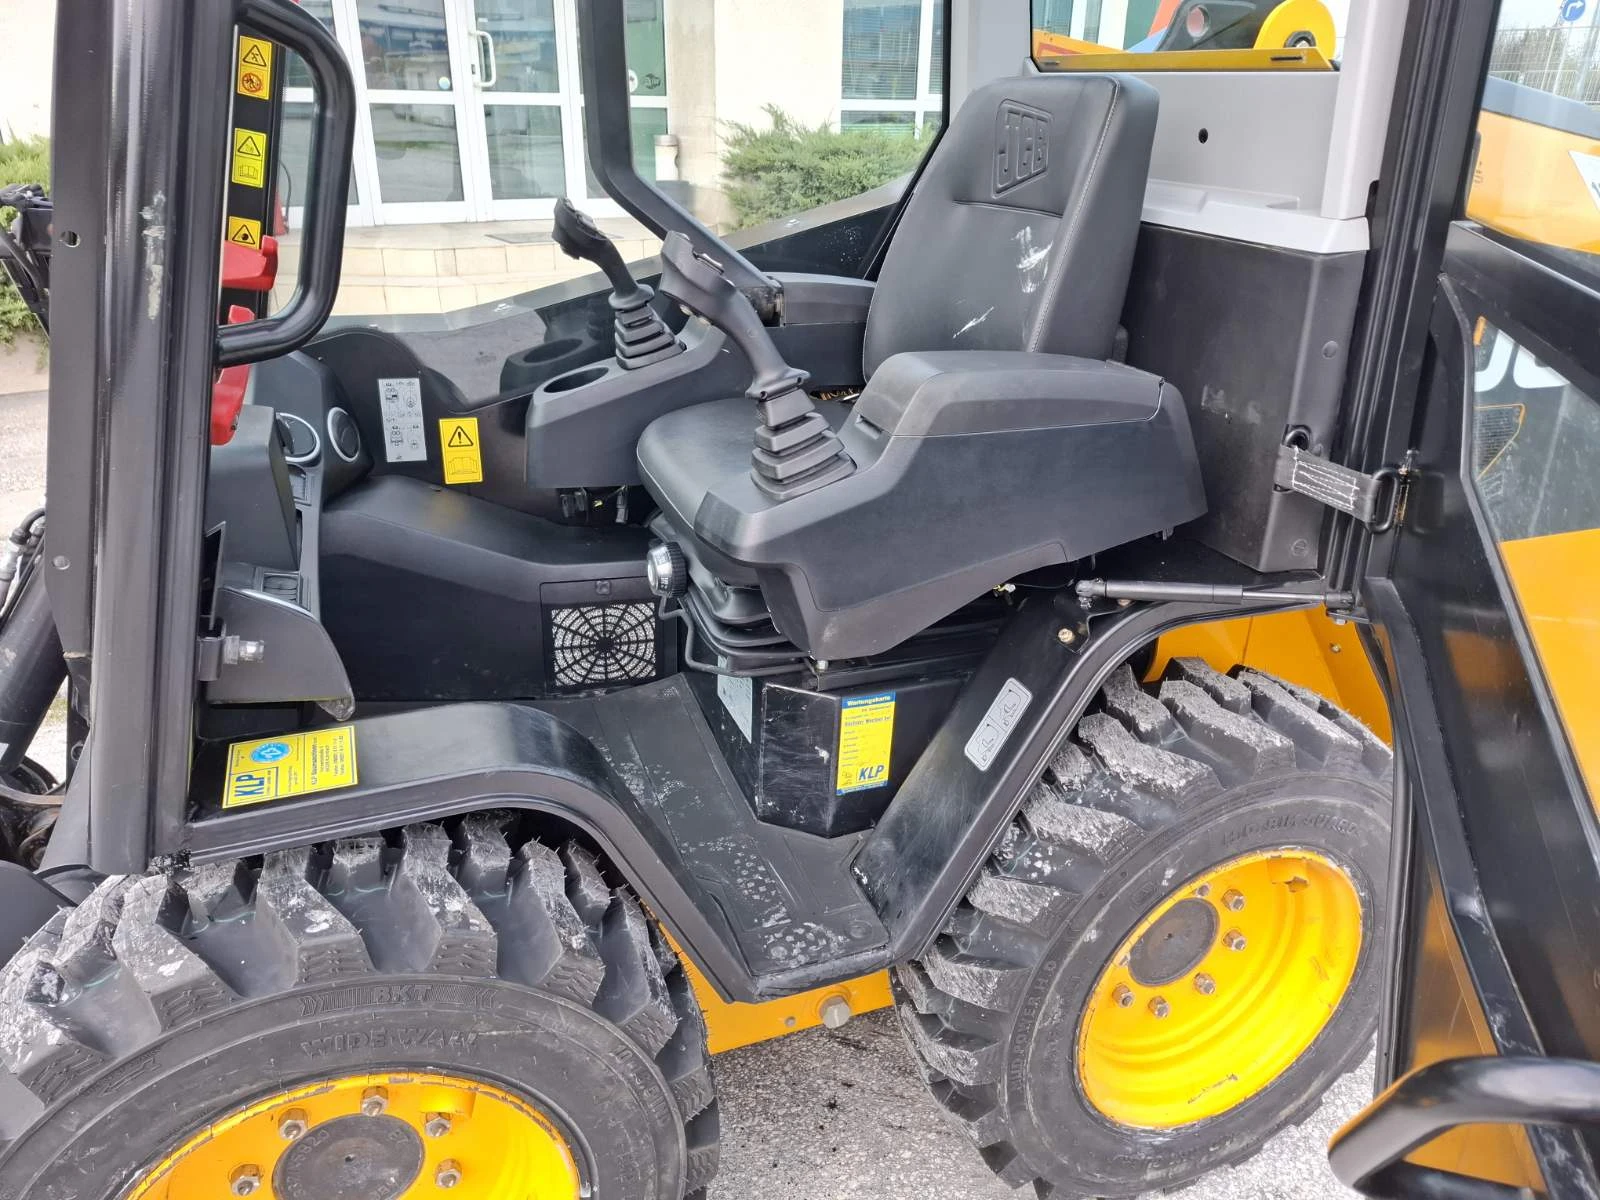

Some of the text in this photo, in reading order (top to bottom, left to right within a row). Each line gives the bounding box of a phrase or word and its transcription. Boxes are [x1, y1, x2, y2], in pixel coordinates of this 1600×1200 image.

[995, 105, 1049, 190] JCB
[858, 764, 885, 781] KLP
[234, 774, 265, 797] KLP
[373, 984, 432, 1002] BKT
